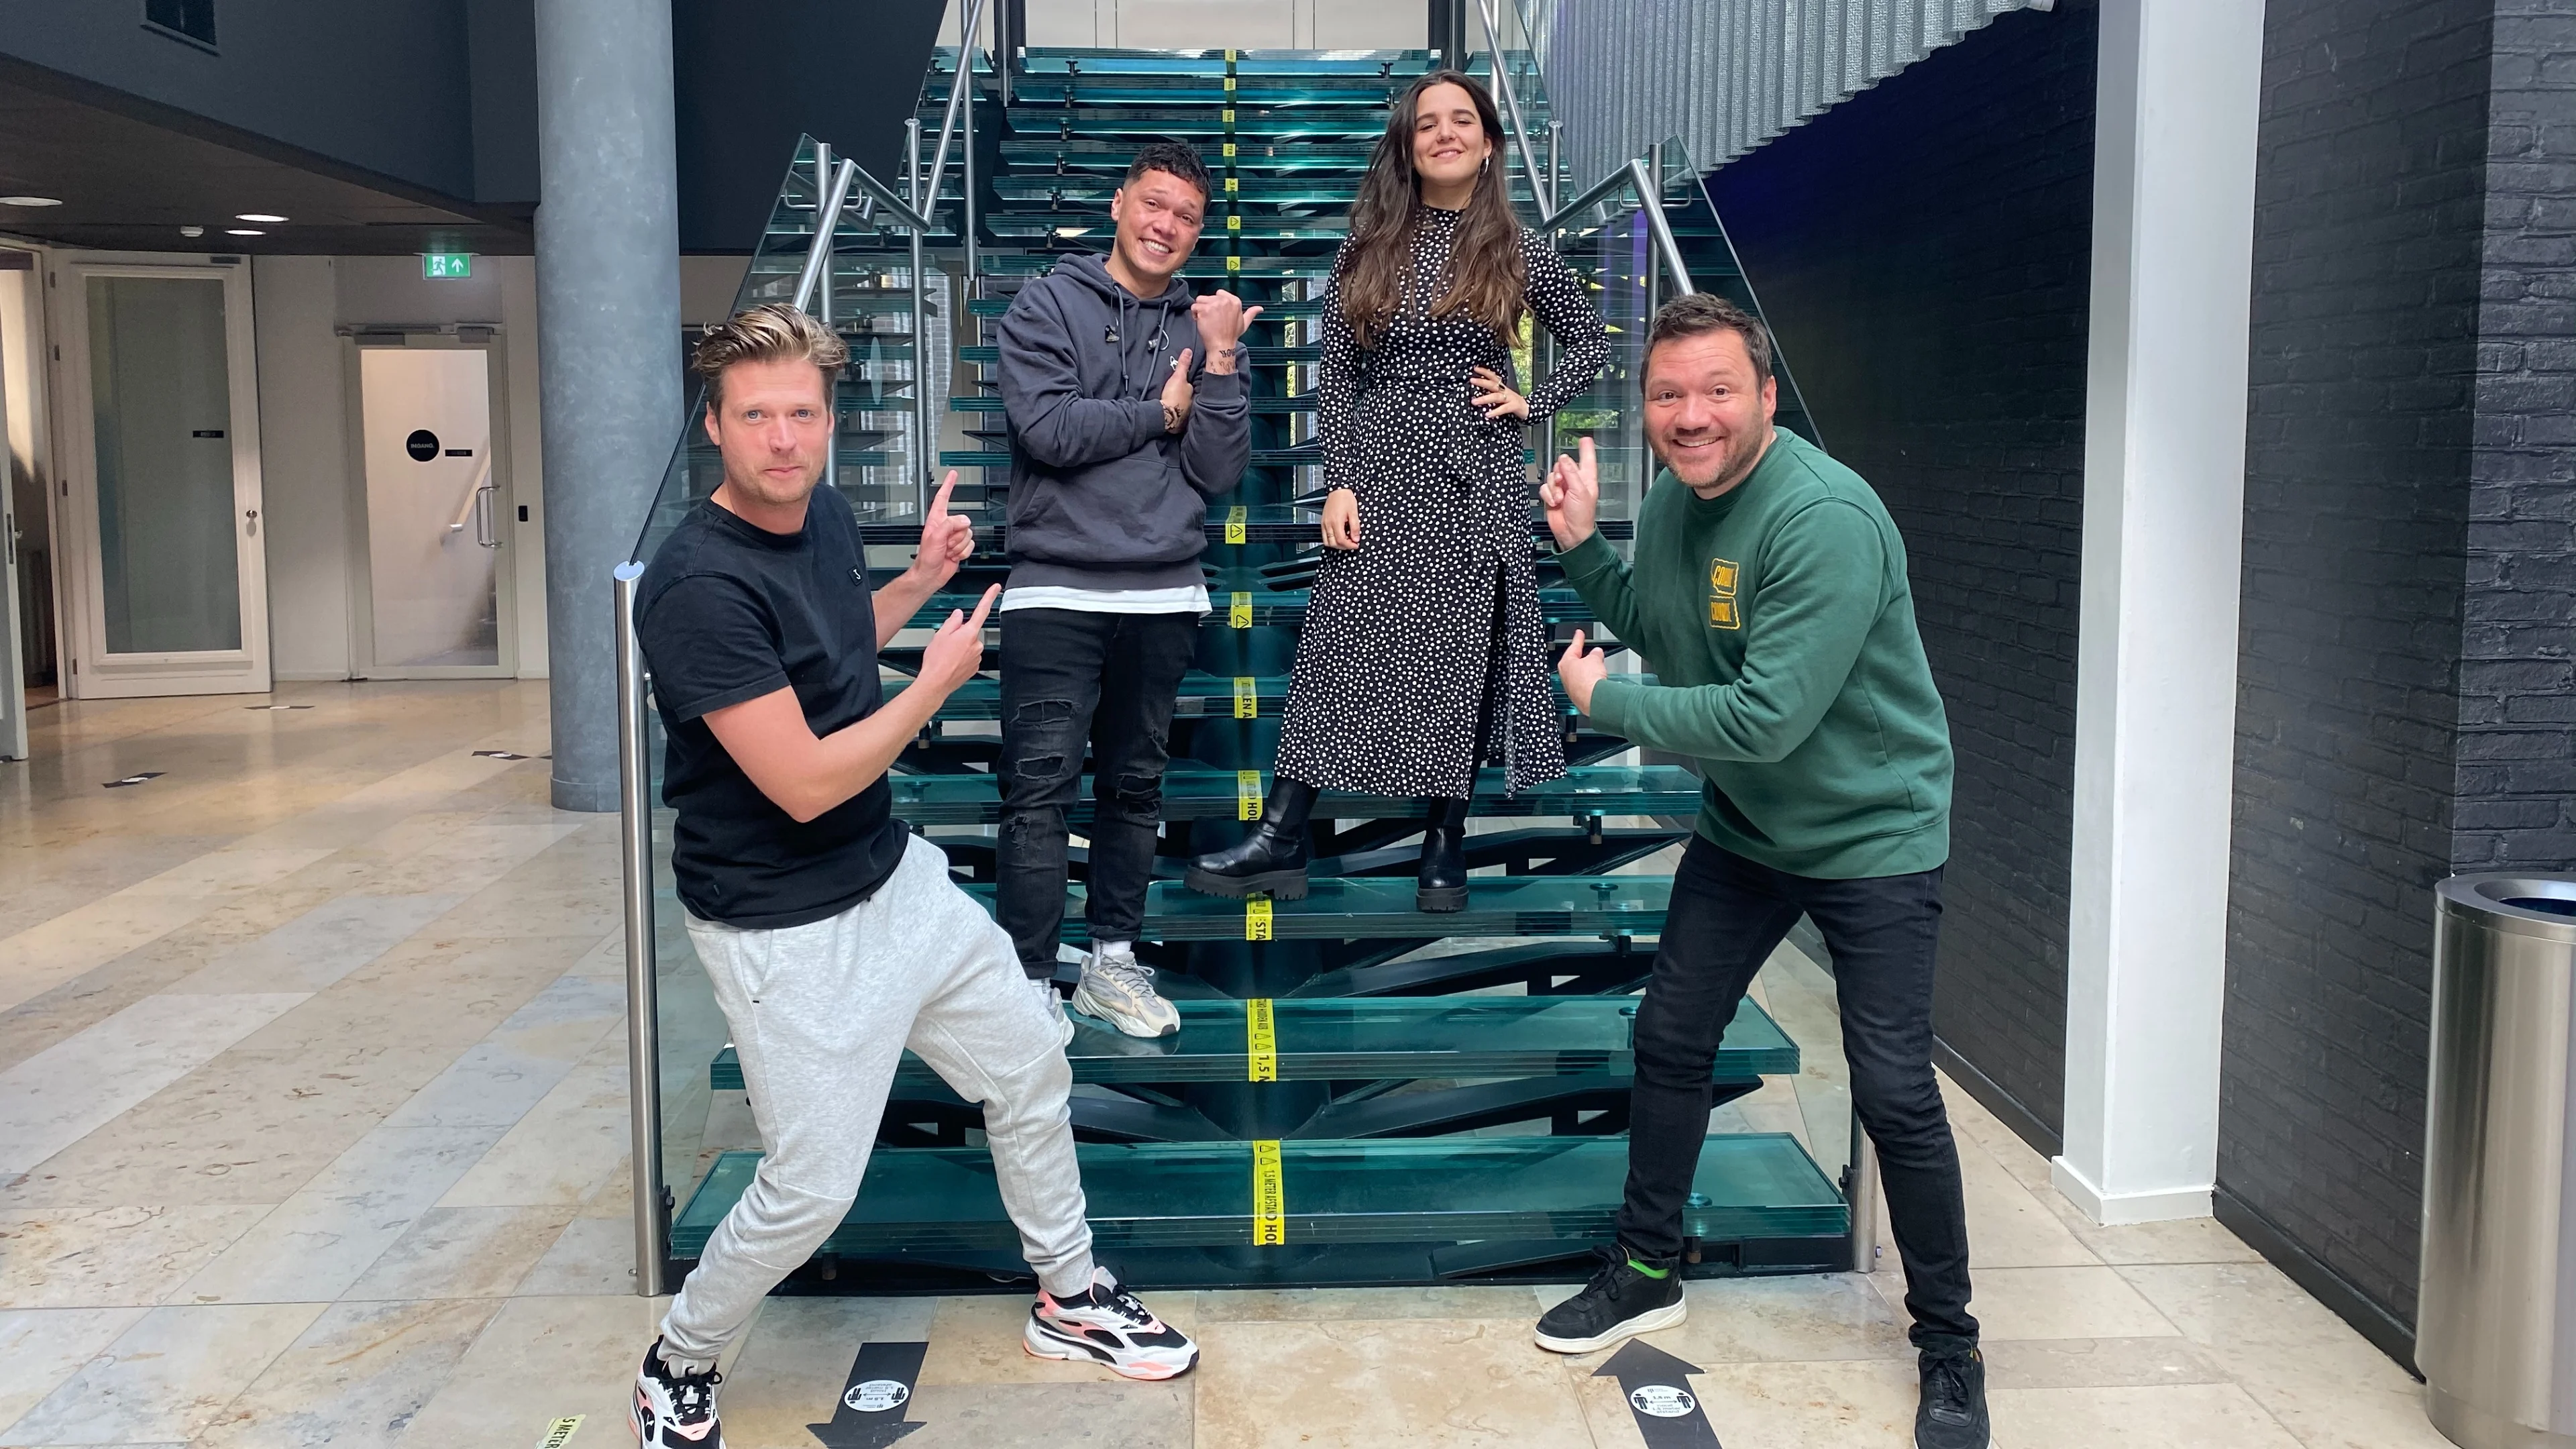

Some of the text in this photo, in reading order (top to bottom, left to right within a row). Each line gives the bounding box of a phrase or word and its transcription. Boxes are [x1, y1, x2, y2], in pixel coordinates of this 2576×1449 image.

[1256, 1055, 1270, 1073] 1,5
[1265, 1179, 1277, 1195] METER
[1265, 1195, 1278, 1222] AFSTAND
[544, 1424, 573, 1449] METER
